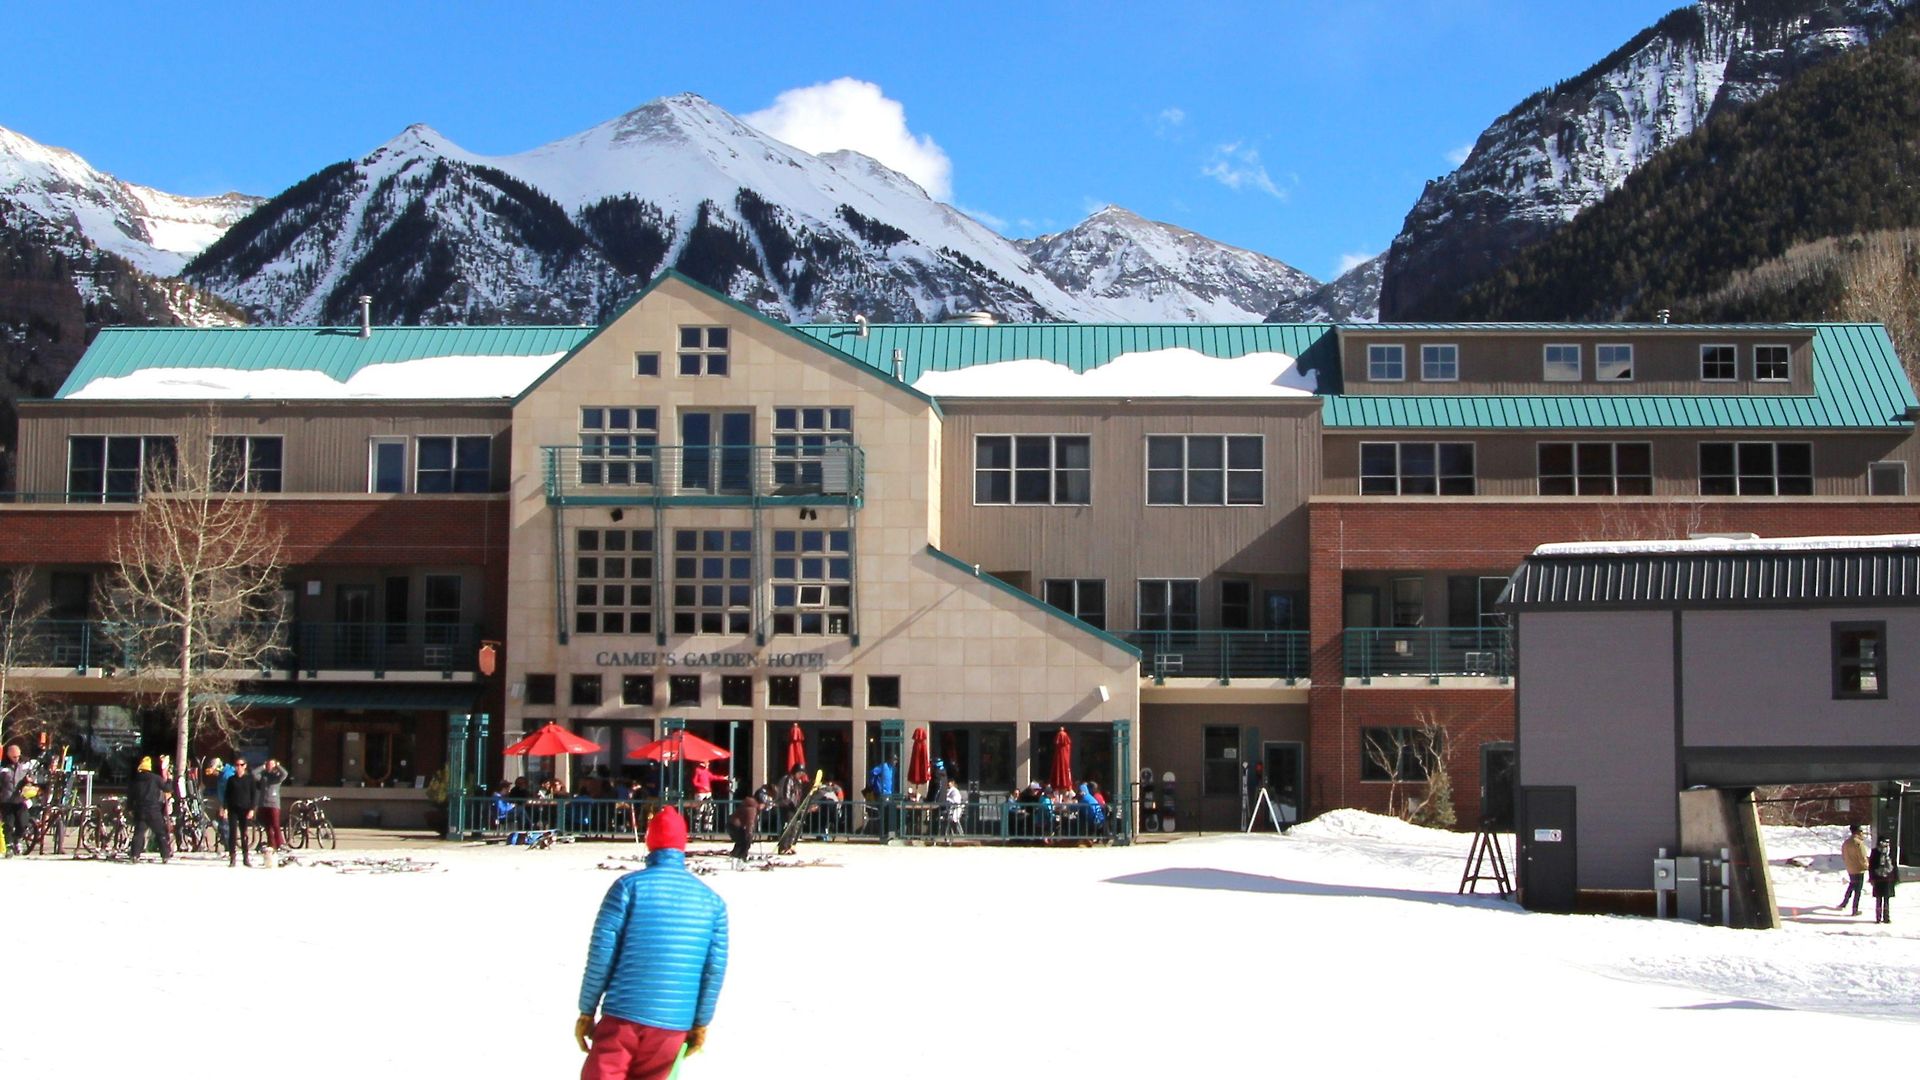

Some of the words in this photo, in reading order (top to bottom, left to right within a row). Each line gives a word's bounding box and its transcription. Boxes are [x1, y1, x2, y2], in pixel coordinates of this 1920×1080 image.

[596, 651, 677, 667] CAMEL'S
[684, 652, 760, 667] GARDEN
[767, 652, 828, 667] HOTEL
